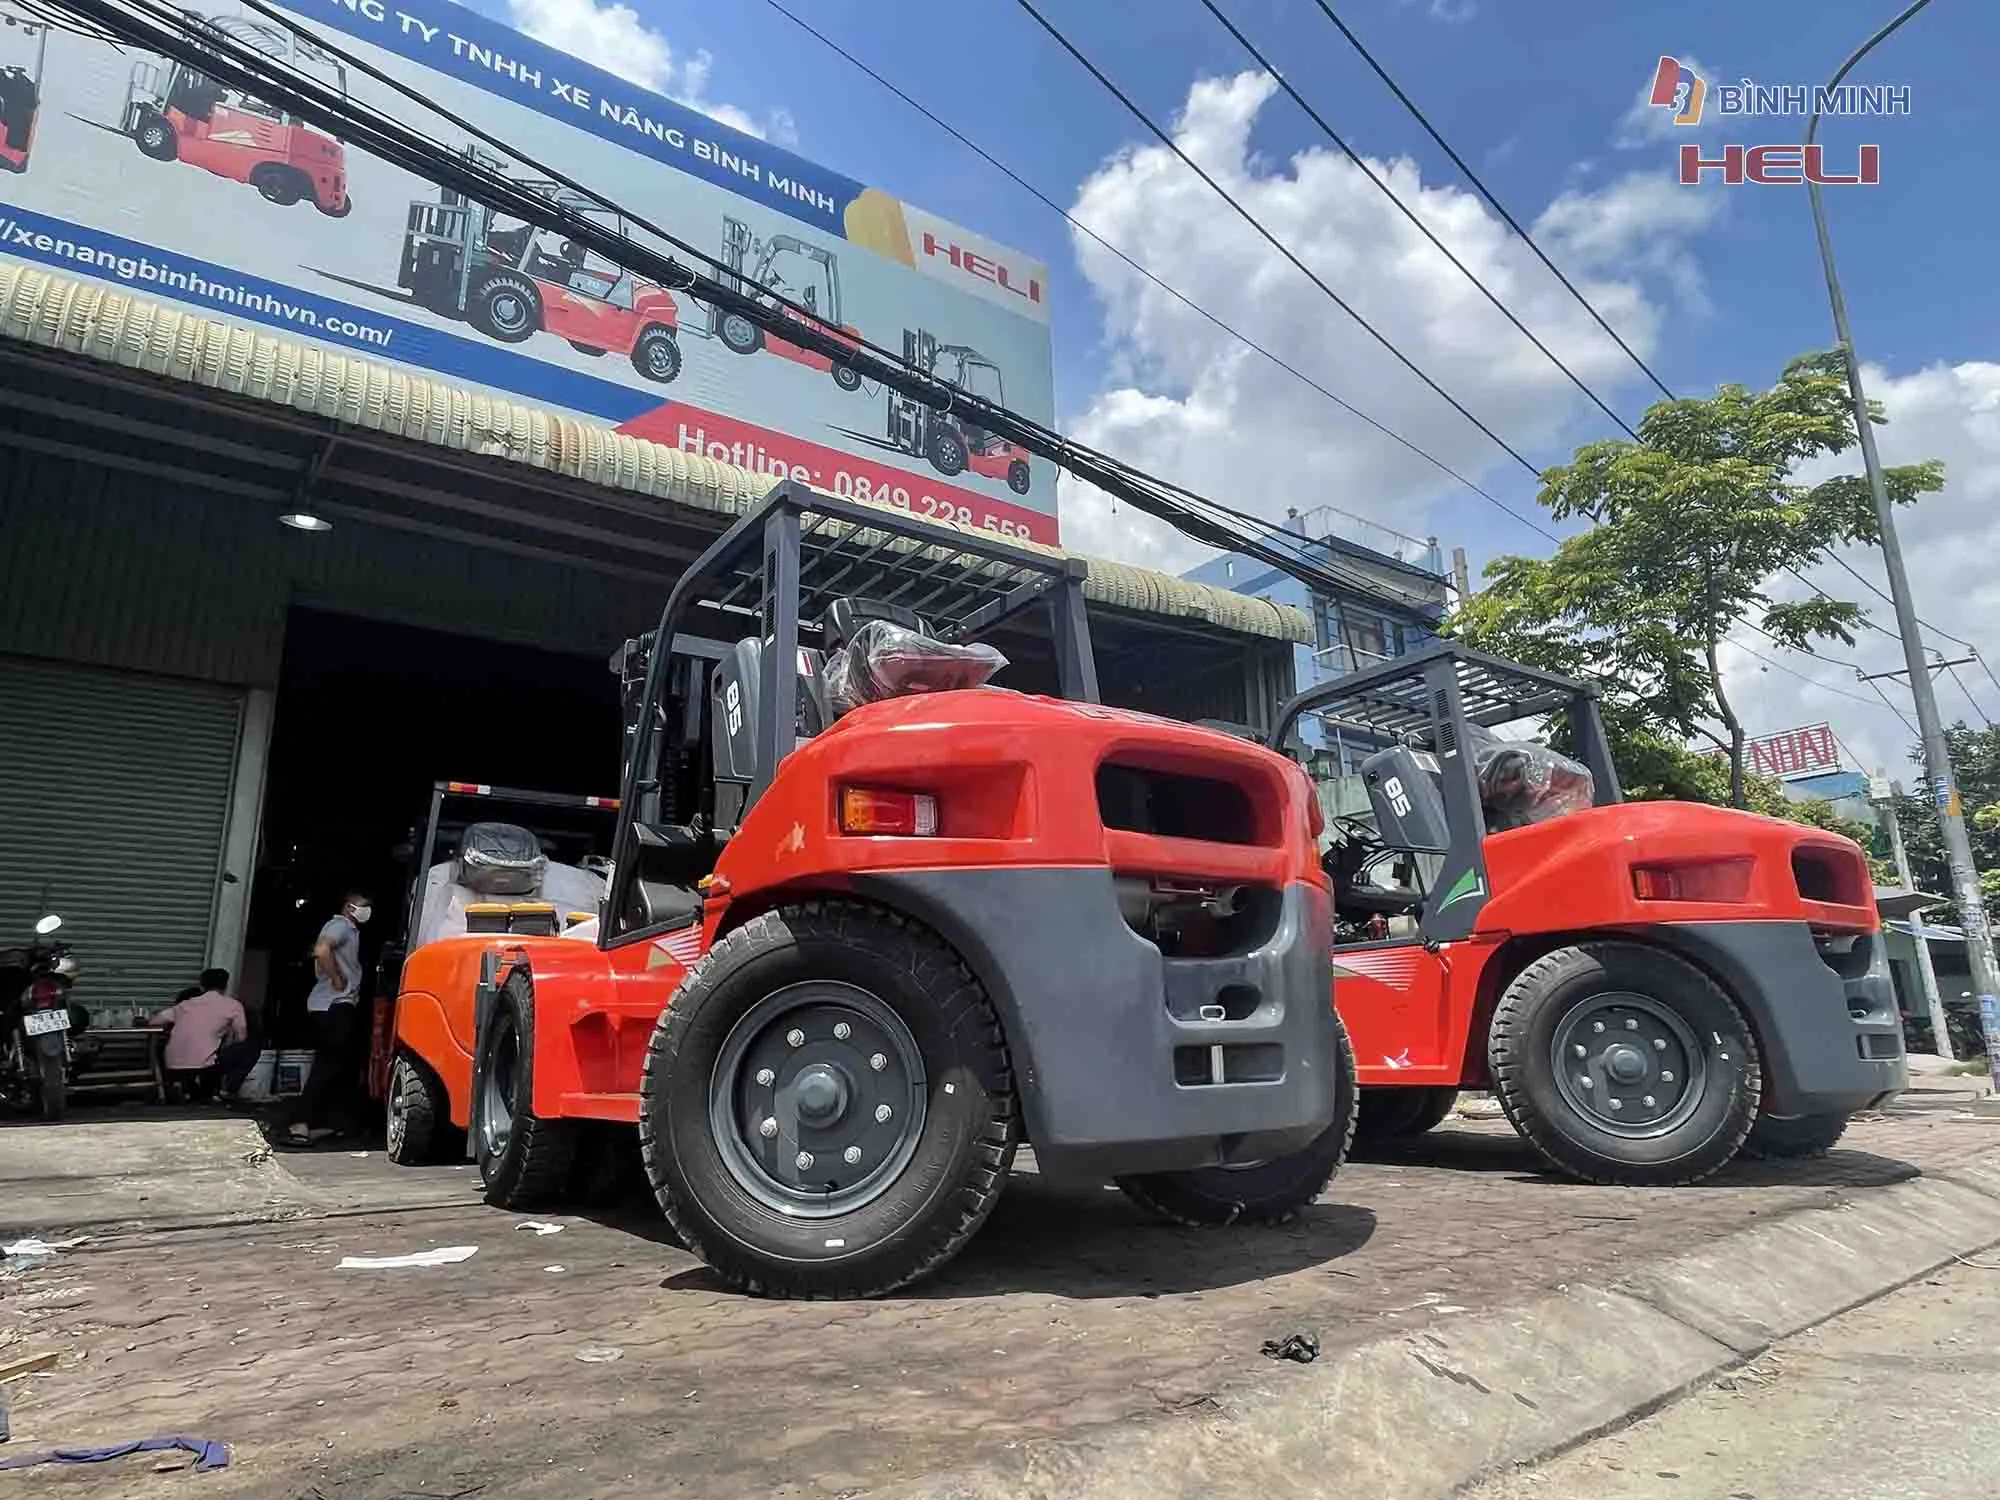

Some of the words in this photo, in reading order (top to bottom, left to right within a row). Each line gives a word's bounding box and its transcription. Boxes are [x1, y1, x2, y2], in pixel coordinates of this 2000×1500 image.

[395, 10, 439, 43] TY
[447, 33, 541, 89] TNHH
[552, 78, 590, 111] XE
[600, 99, 685, 147] NÂNG
[694, 136, 760, 182] BÌNH
[769, 173, 834, 214] MINH
[923, 232, 1040, 303] HELI
[678, 423, 820, 486] Hotline:
[834, 472, 910, 511] 0849
[920, 495, 973, 526] 228
